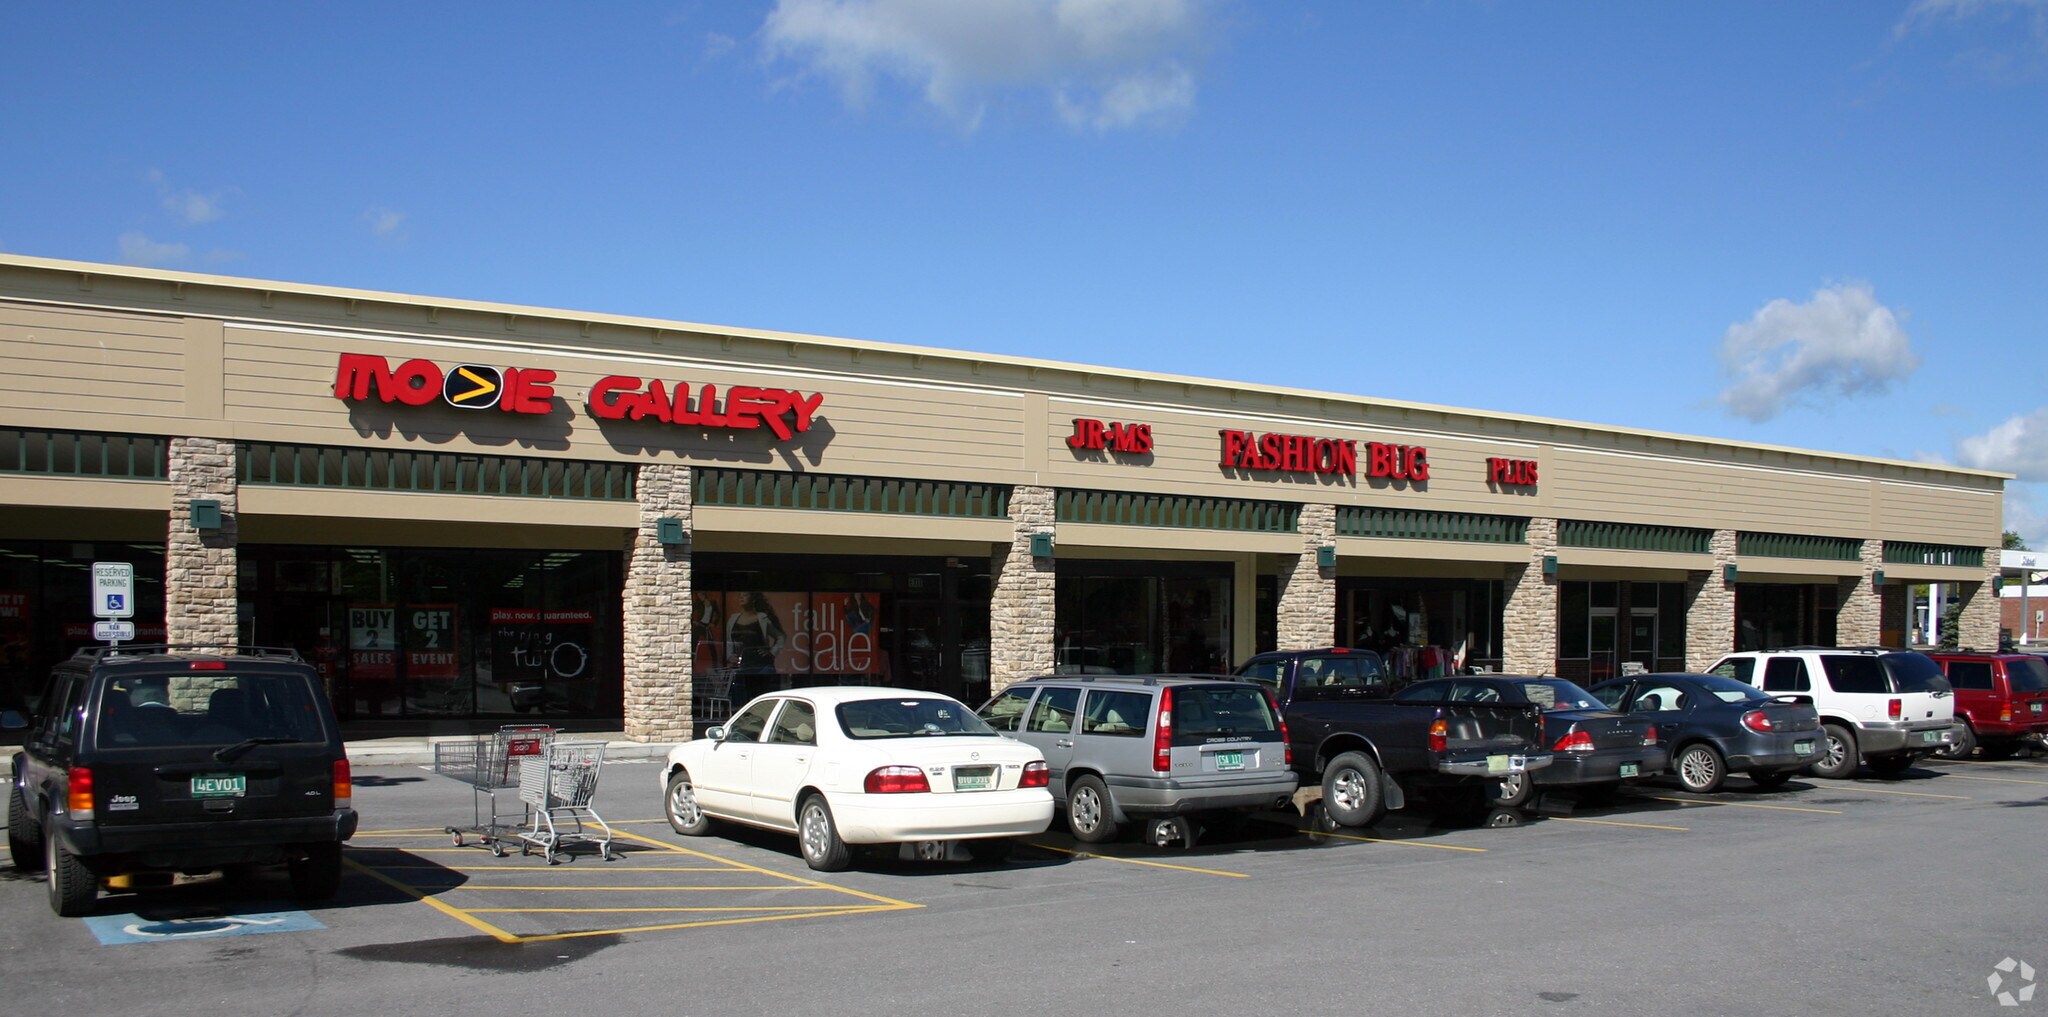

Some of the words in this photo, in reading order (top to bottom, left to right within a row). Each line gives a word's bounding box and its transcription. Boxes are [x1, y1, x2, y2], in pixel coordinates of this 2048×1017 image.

[589, 374, 824, 441] GALLERY
[1220, 430, 1357, 476] FASHION
[1366, 441, 1430, 481] BUG
[1487, 457, 1538, 485] PLUS
[96, 568, 130, 577] RESERVED
[100, 578, 127, 587] PARKING
[352, 611, 392, 629] BUY
[412, 611, 450, 629] GET
[493, 612, 513, 620] play.
[791, 603, 835, 631] fall
[366, 630, 379, 647] 2
[425, 631, 438, 648] 2
[519, 631, 552, 645] ring
[791, 621, 872, 672] sale
[353, 653, 392, 664] SALES
[412, 653, 454, 665] EVENT
[111, 794, 137, 803] Jeep
